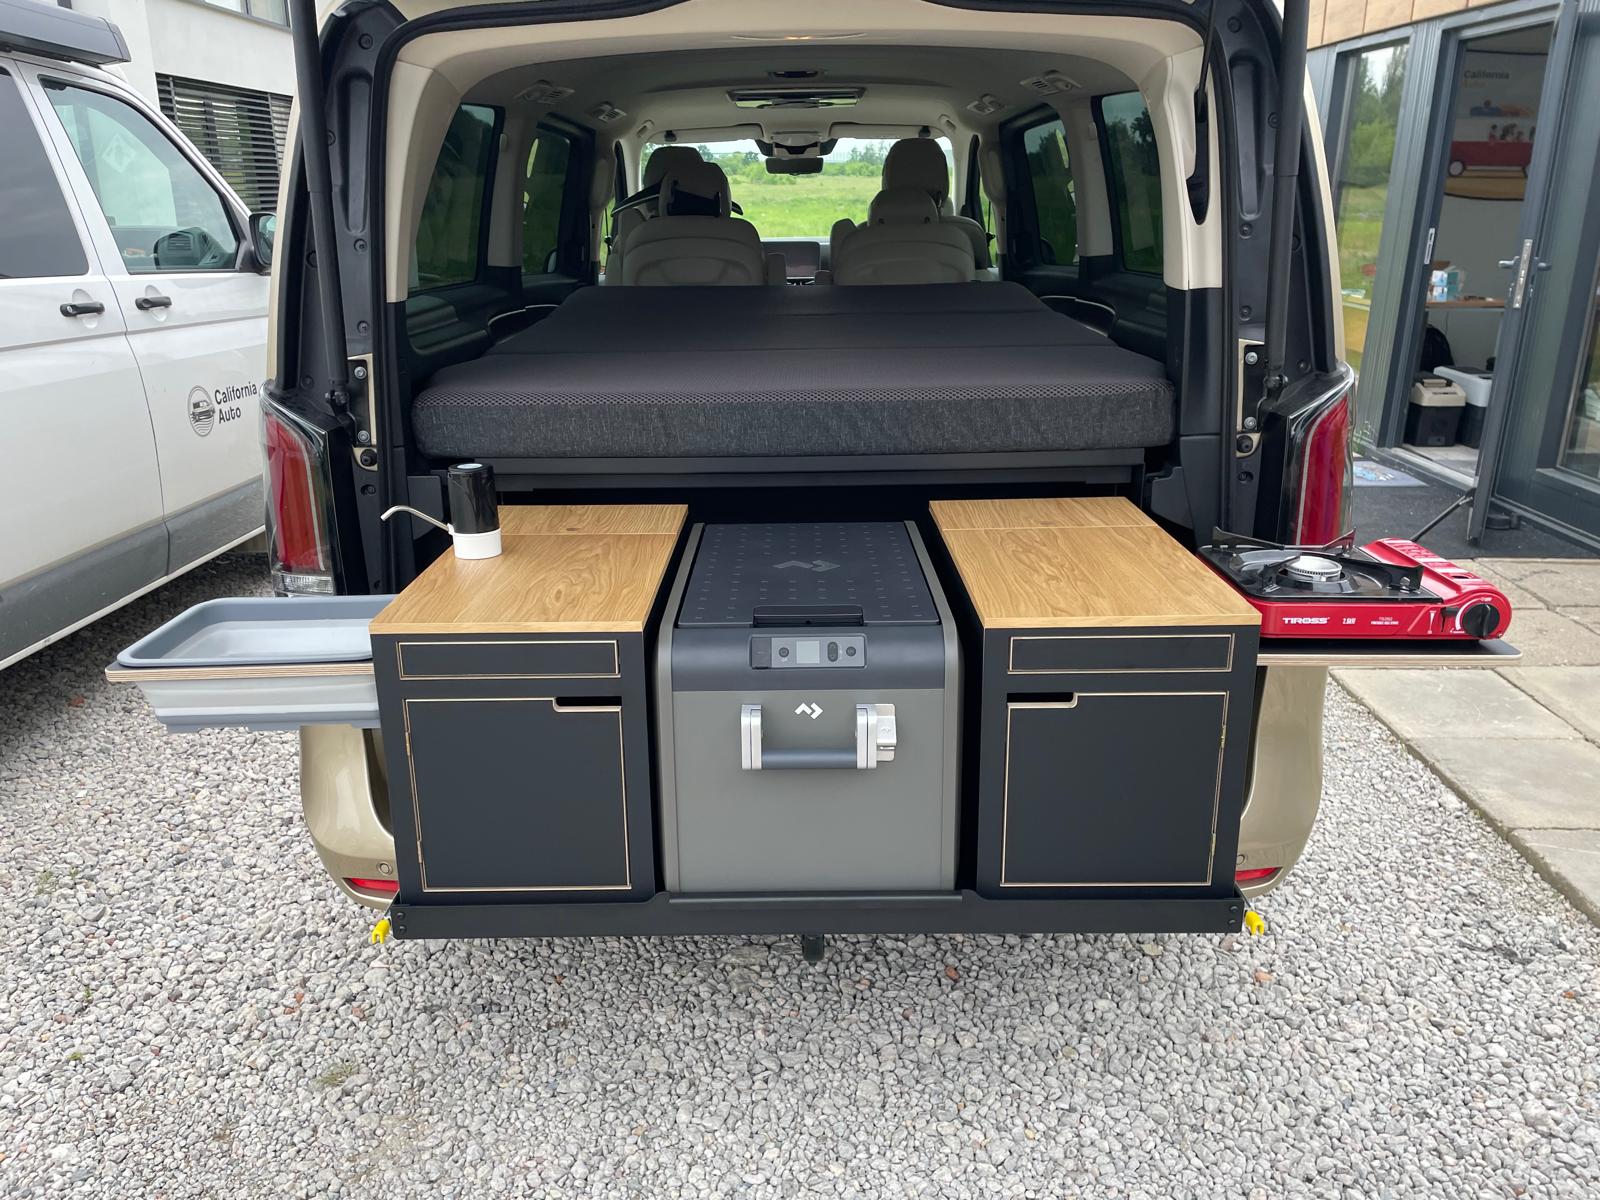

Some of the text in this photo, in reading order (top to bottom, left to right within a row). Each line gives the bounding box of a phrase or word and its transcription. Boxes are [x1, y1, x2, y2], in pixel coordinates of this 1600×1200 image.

[214, 381, 257, 405] California
[218, 406, 241, 424] Auto
[1282, 617, 1328, 625] TIROSS
